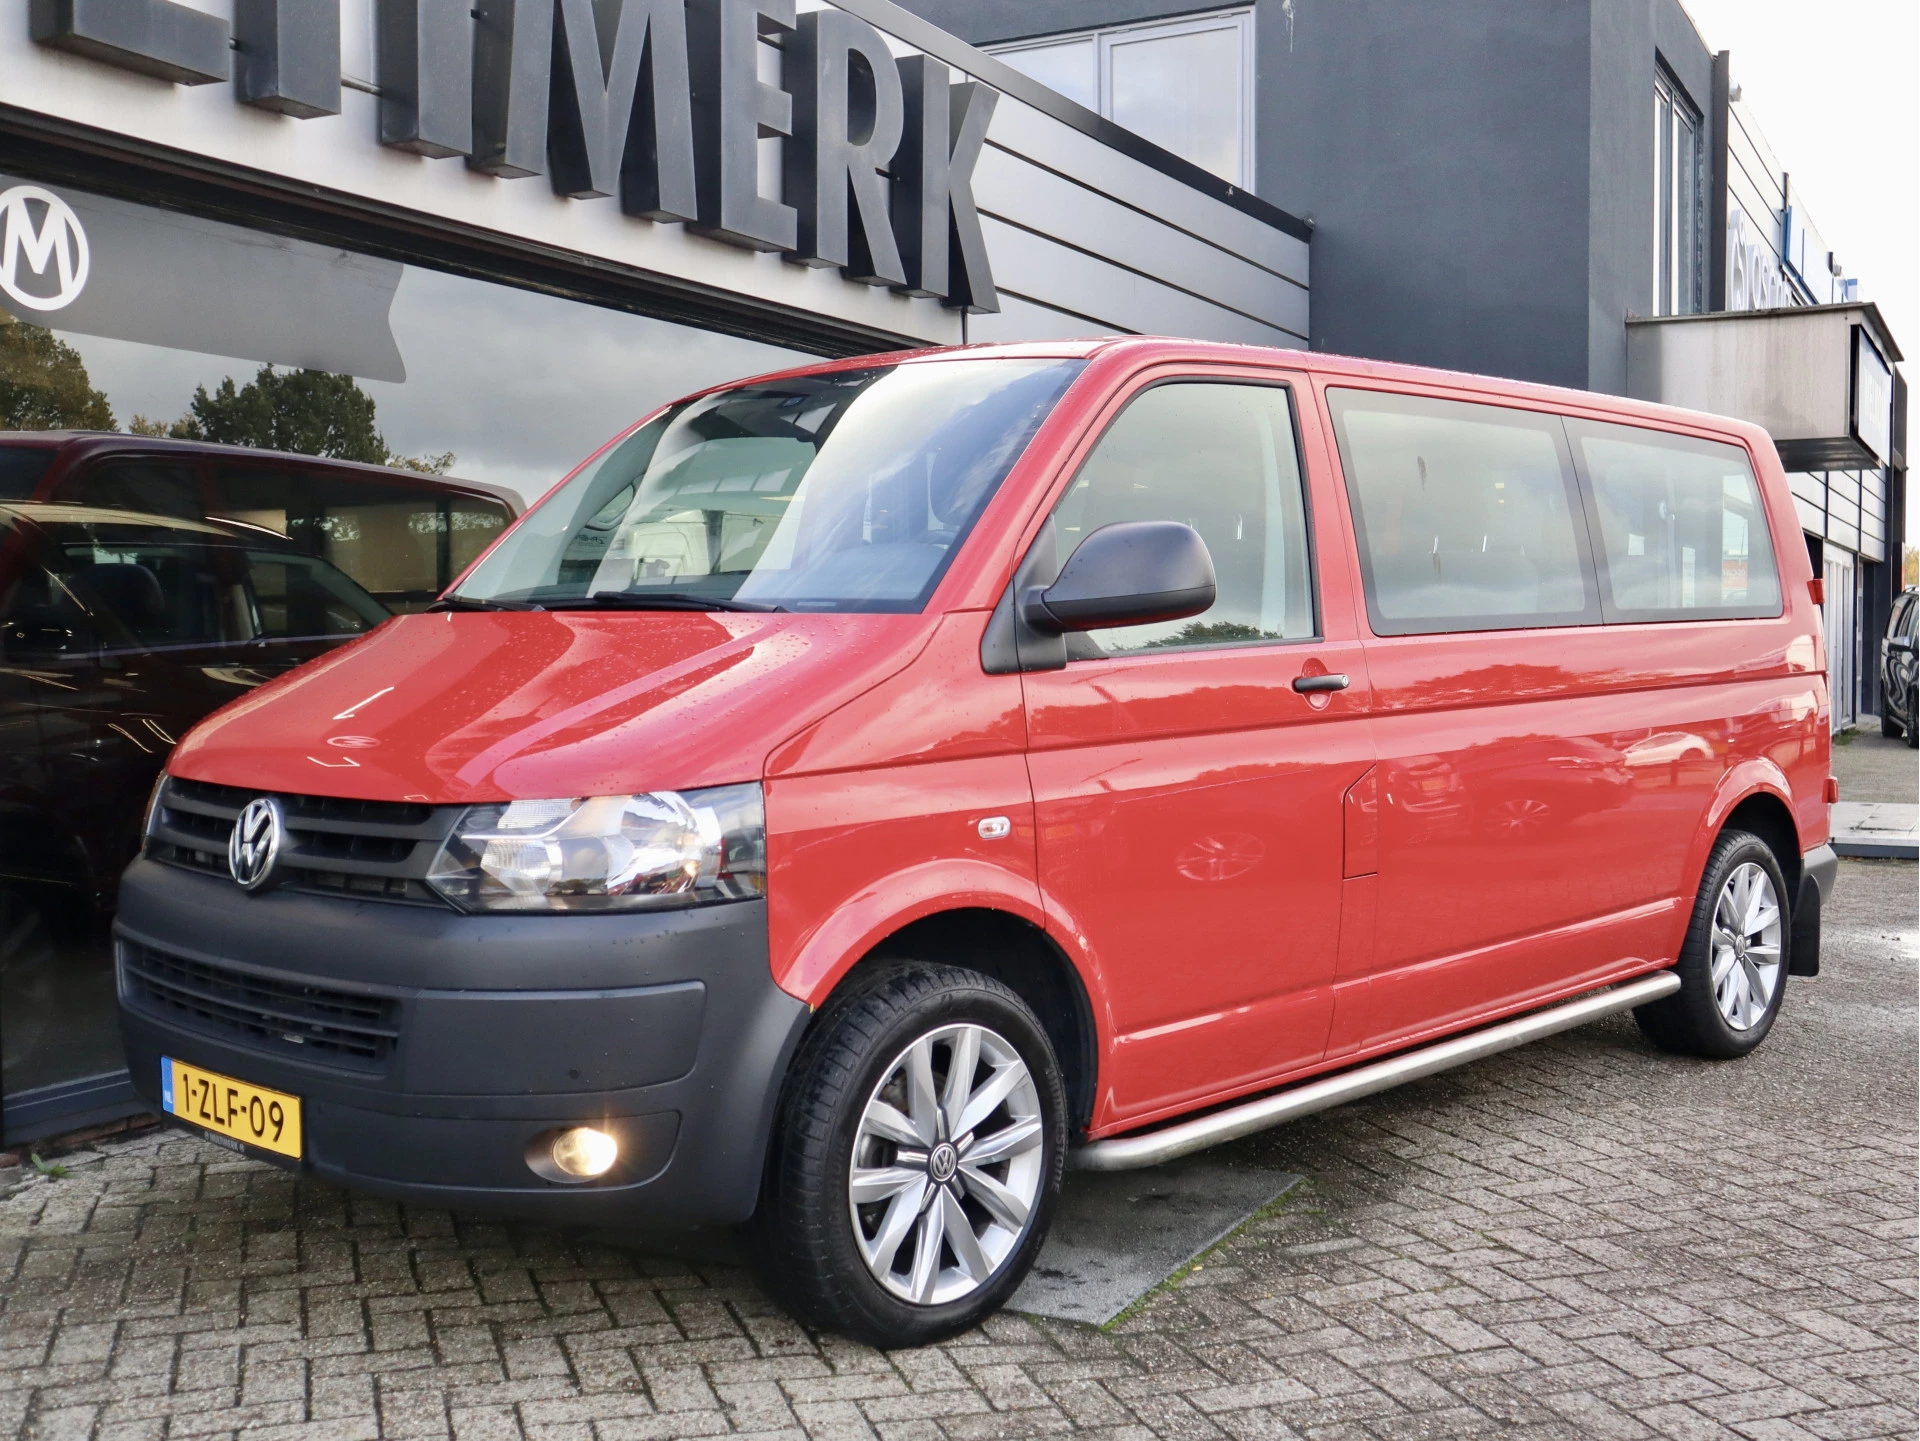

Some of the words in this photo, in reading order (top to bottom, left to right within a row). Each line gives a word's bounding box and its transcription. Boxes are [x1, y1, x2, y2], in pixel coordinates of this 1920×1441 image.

[30, 0, 1000, 314] MERK
[2, 194, 74, 300] M
[182, 1073, 285, 1143] 1-ZLF-09
